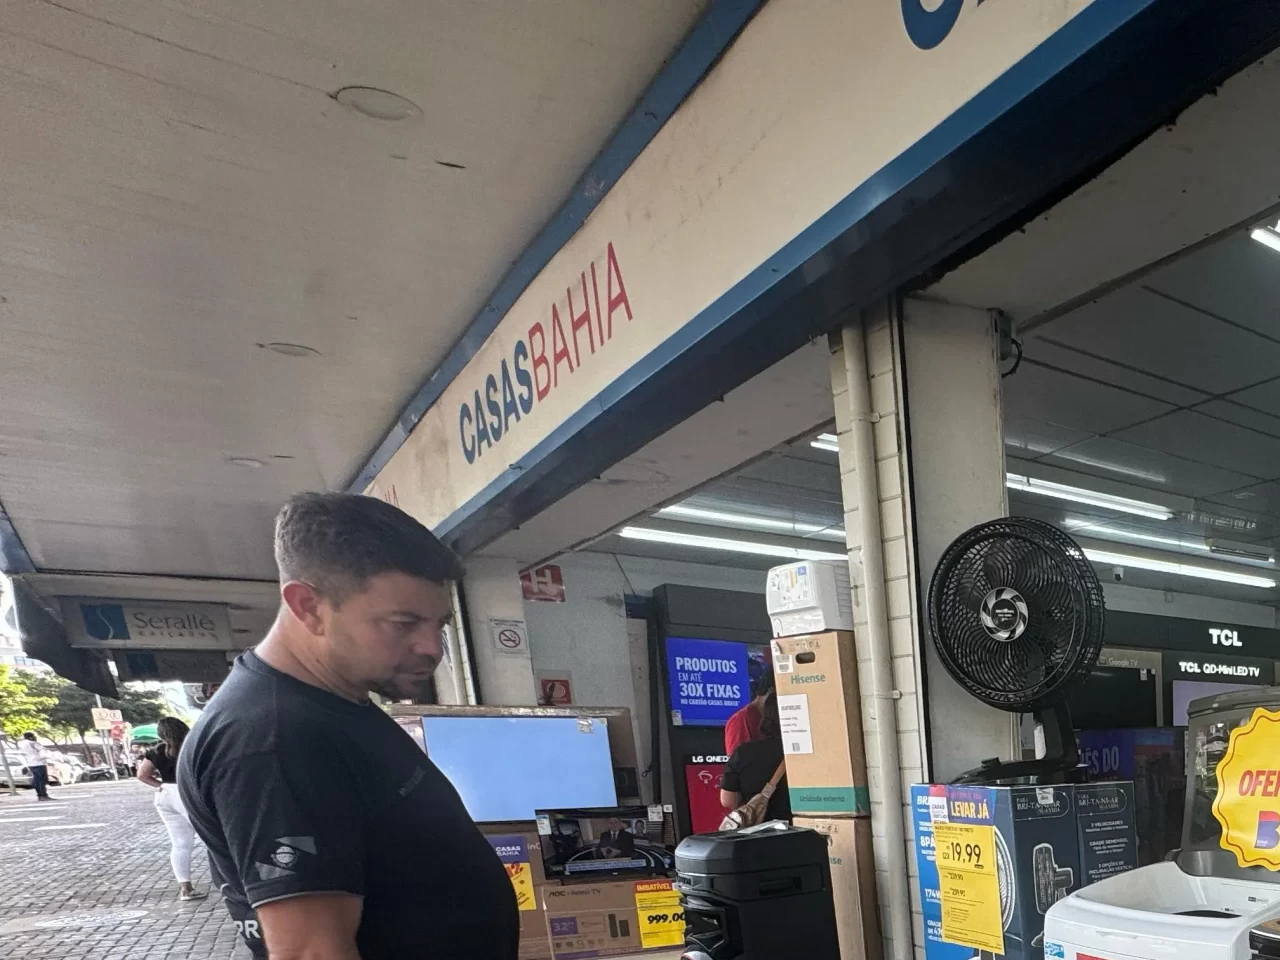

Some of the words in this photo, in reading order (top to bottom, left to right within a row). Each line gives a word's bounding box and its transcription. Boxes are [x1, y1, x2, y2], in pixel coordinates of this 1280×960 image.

[1208, 628, 1243, 647] TCL
[675, 656, 737, 674] PRODUTOS
[1108, 656, 1129, 668] Google
[1129, 658, 1138, 668] TV
[1179, 661, 1202, 673] TCL
[1249, 666, 1261, 678] TV
[678, 672, 688, 681] EM
[690, 671, 703, 682] ATÉ
[791, 673, 826, 685] Hisense
[680, 682, 705, 697] 30X
[706, 683, 741, 699] FIXAS
[692, 755, 704, 763] LG
[1102, 745, 1120, 772] DO
[950, 801, 976, 818] LEVAR
[977, 799, 990, 819] JÁ
[636, 881, 671, 891] IMBATÍVEL
